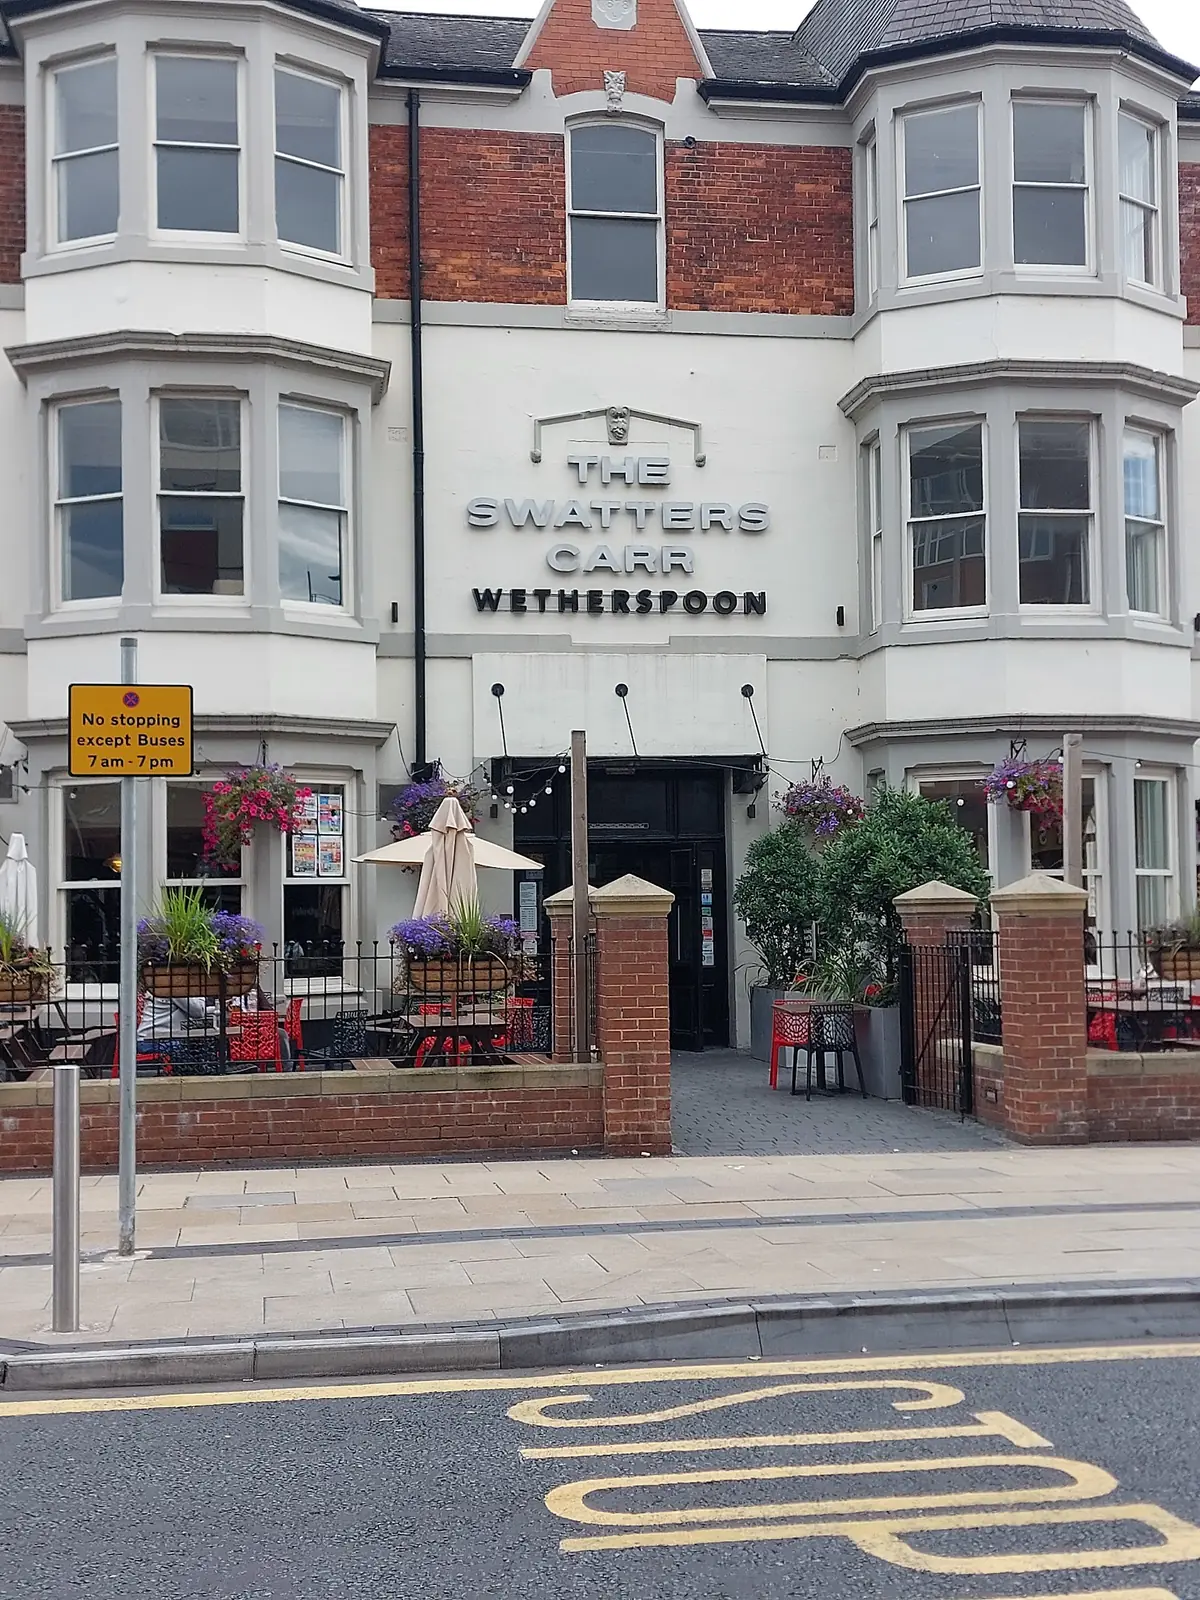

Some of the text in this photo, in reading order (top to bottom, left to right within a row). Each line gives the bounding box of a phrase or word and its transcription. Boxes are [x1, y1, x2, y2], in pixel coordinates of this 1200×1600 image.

[567, 455, 671, 485] THE
[466, 497, 771, 531] SWATTERS
[546, 544, 695, 573] CARR
[472, 588, 766, 615] WETHERSPOON
[82, 713, 181, 729] No stopping
[77, 734, 185, 748] except Buses
[506, 1379, 1200, 1575] STOP
